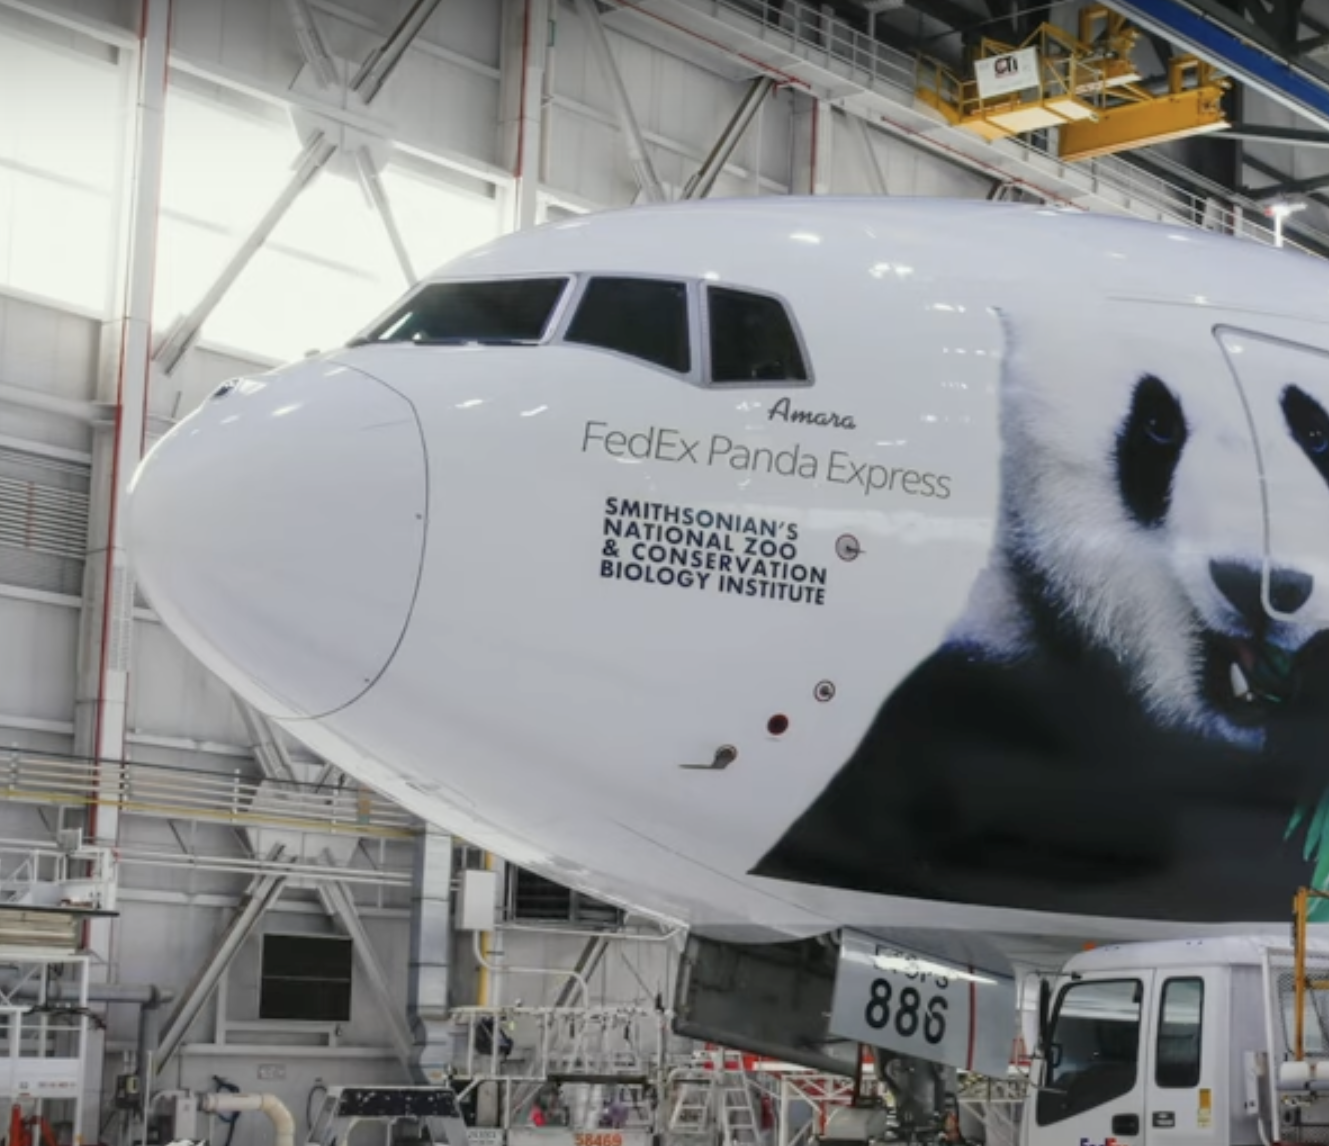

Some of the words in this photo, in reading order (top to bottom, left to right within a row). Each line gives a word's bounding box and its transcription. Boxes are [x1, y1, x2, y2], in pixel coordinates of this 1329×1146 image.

[767, 397, 857, 431] Amara
[582, 420, 700, 464] FedEx
[707, 434, 818, 480] Panda
[826, 450, 953, 499] Express
[601, 538, 620, 559] &
[631, 542, 827, 586] CONSERVATION
[603, 518, 735, 553] NATIONAL
[743, 537, 798, 561] ZOO
[600, 559, 711, 590] BIOLOGY
[718, 574, 826, 606] INSTITUTE
[865, 977, 949, 1045] 886
